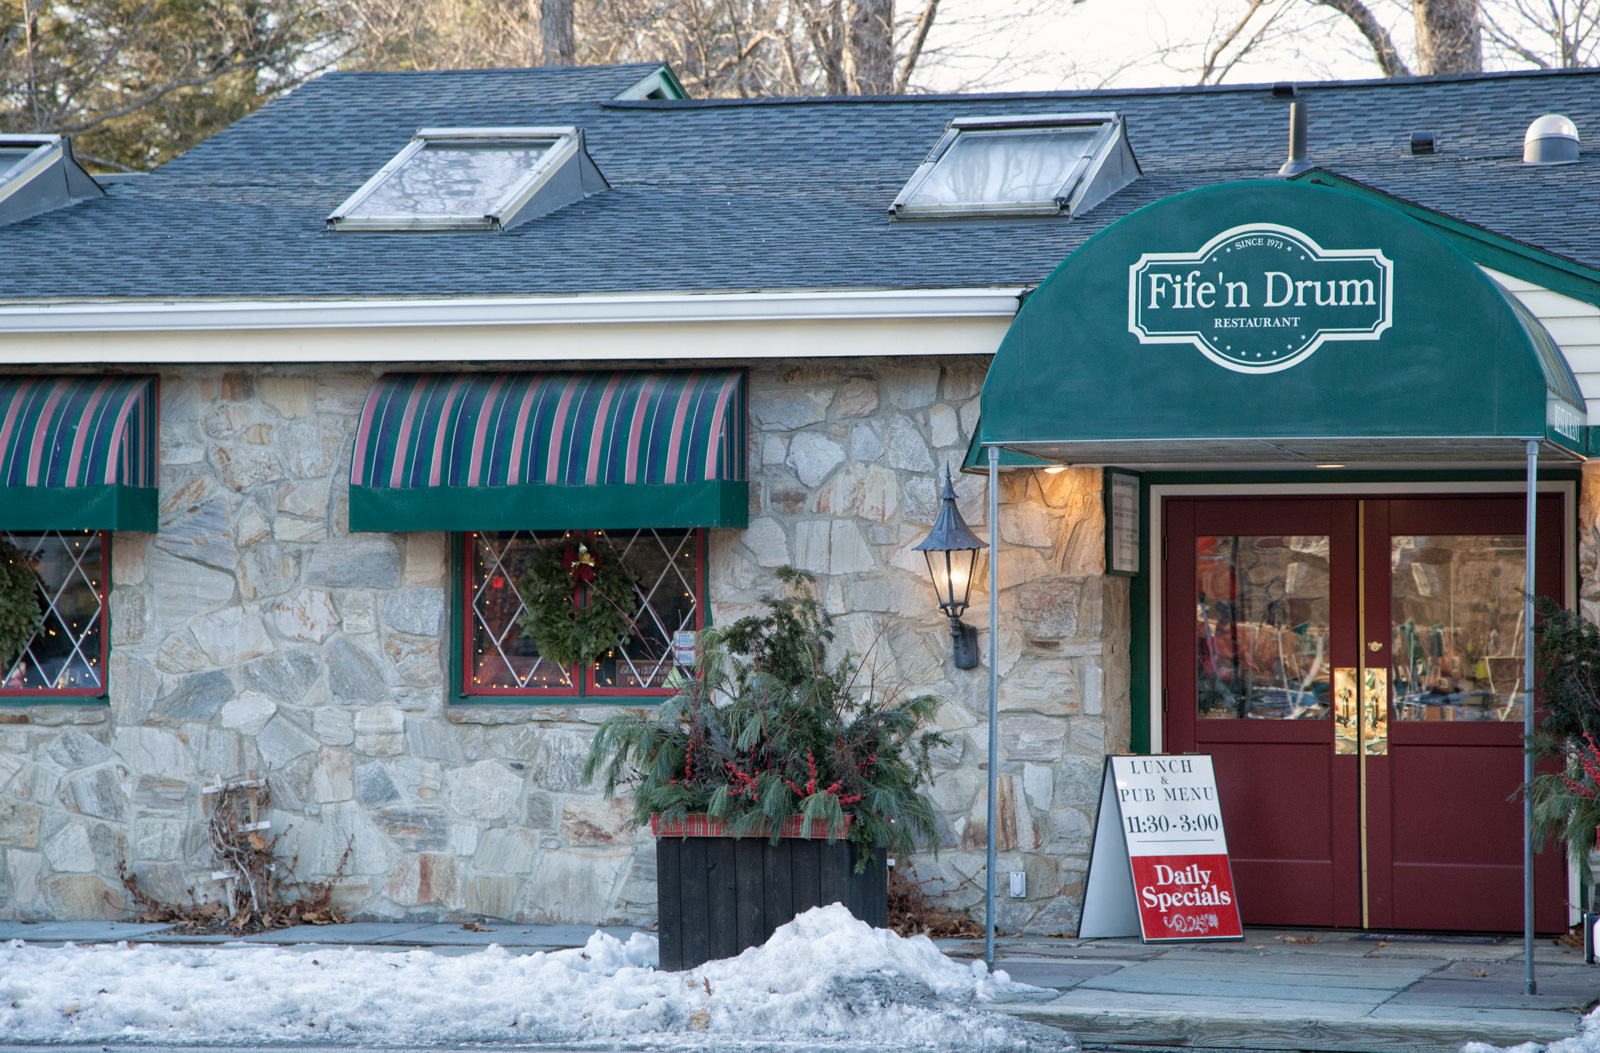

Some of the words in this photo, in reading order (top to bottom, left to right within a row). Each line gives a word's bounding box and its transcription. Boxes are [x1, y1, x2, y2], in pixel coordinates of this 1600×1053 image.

[1235, 238, 1264, 250] SINCE
[1267, 238, 1284, 250] 1973
[1148, 270, 1251, 309] Fife'n
[1264, 271, 1376, 307] Drum
[1214, 317, 1300, 329] RESTAURANT
[1131, 760, 1193, 774] LUNCH
[1161, 776, 1169, 785] &
[1121, 788, 1156, 803] PUB
[1164, 787, 1214, 801] MENU
[1153, 864, 1212, 889] Daily
[1142, 884, 1232, 913] Specials
